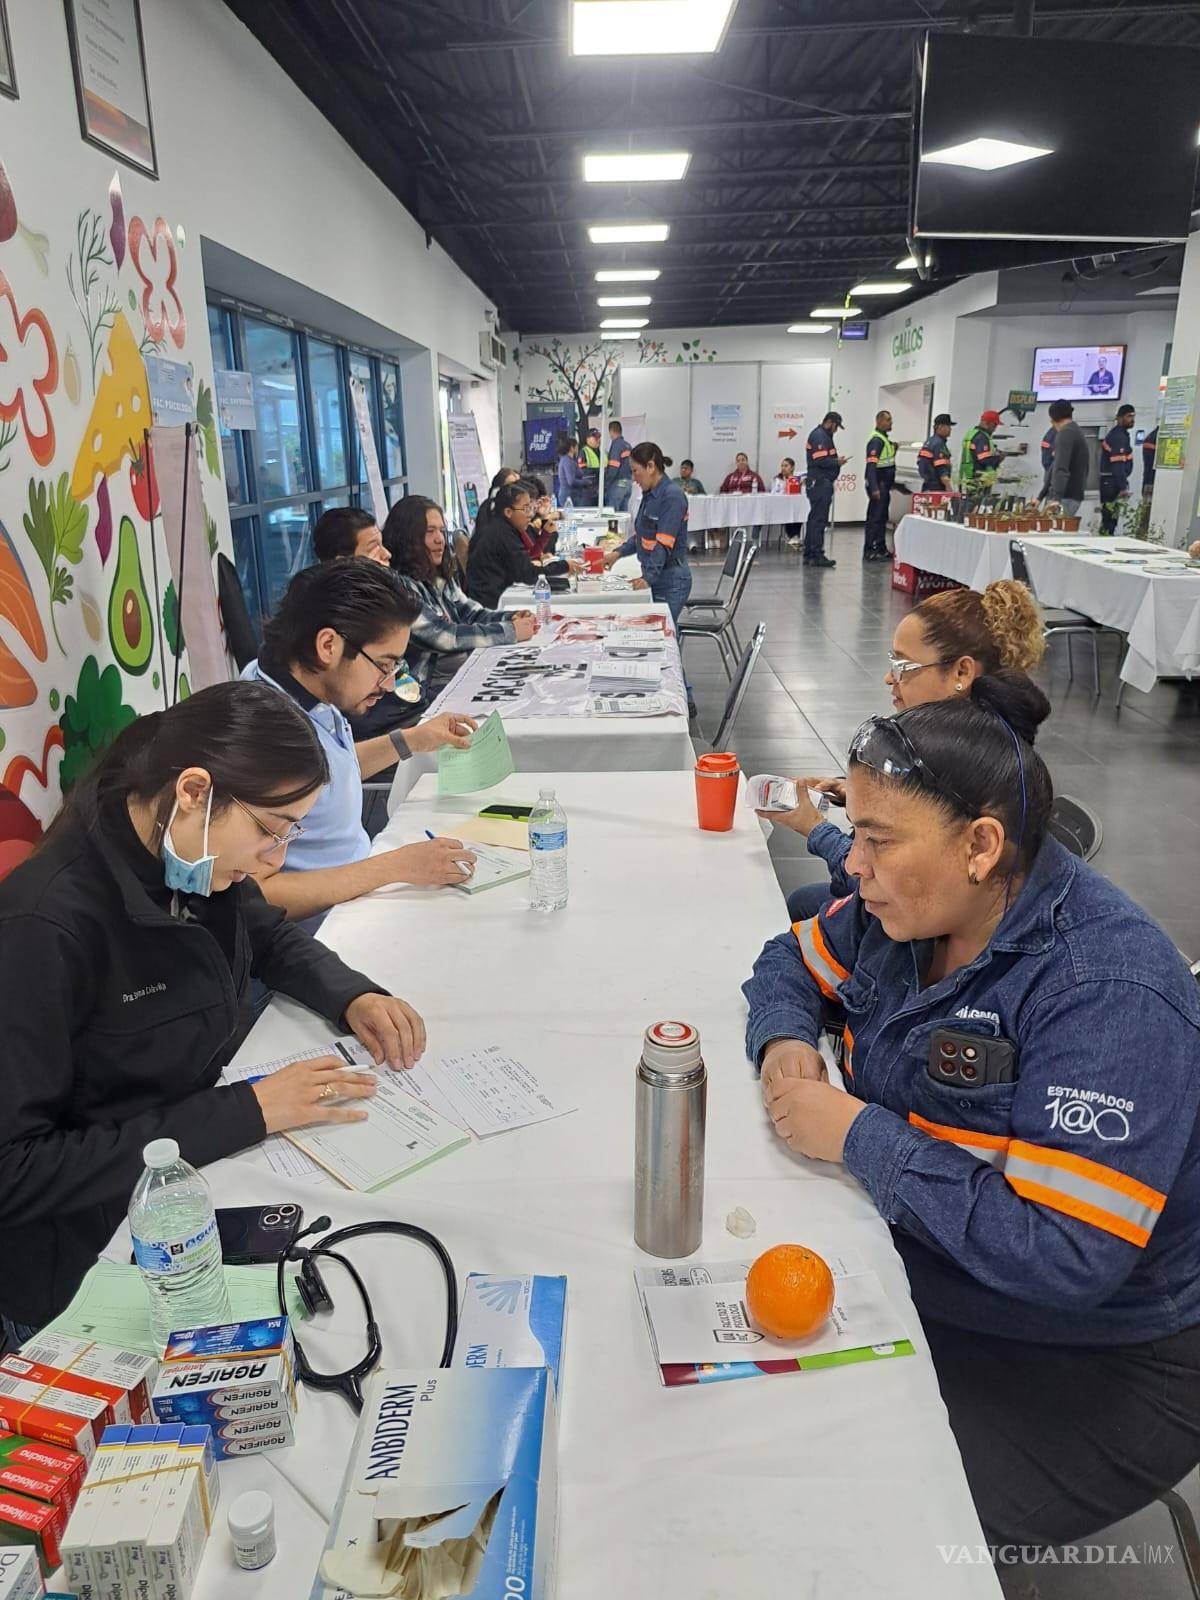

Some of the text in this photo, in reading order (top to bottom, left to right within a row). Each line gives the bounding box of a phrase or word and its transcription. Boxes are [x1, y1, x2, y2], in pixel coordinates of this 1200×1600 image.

[1047, 1086, 1134, 1112] ESTAMPADOS
[170, 1363, 267, 1389] AGRIFEN
[224, 1388, 272, 1402] AGRIFEN
[420, 1379, 438, 1401] Plus
[231, 1400, 278, 1415] AGRIFEN
[234, 1419, 281, 1435] AGRIFEN
[365, 1385, 418, 1480] AMBIDERM
[239, 1436, 286, 1451] AGRIFEN
